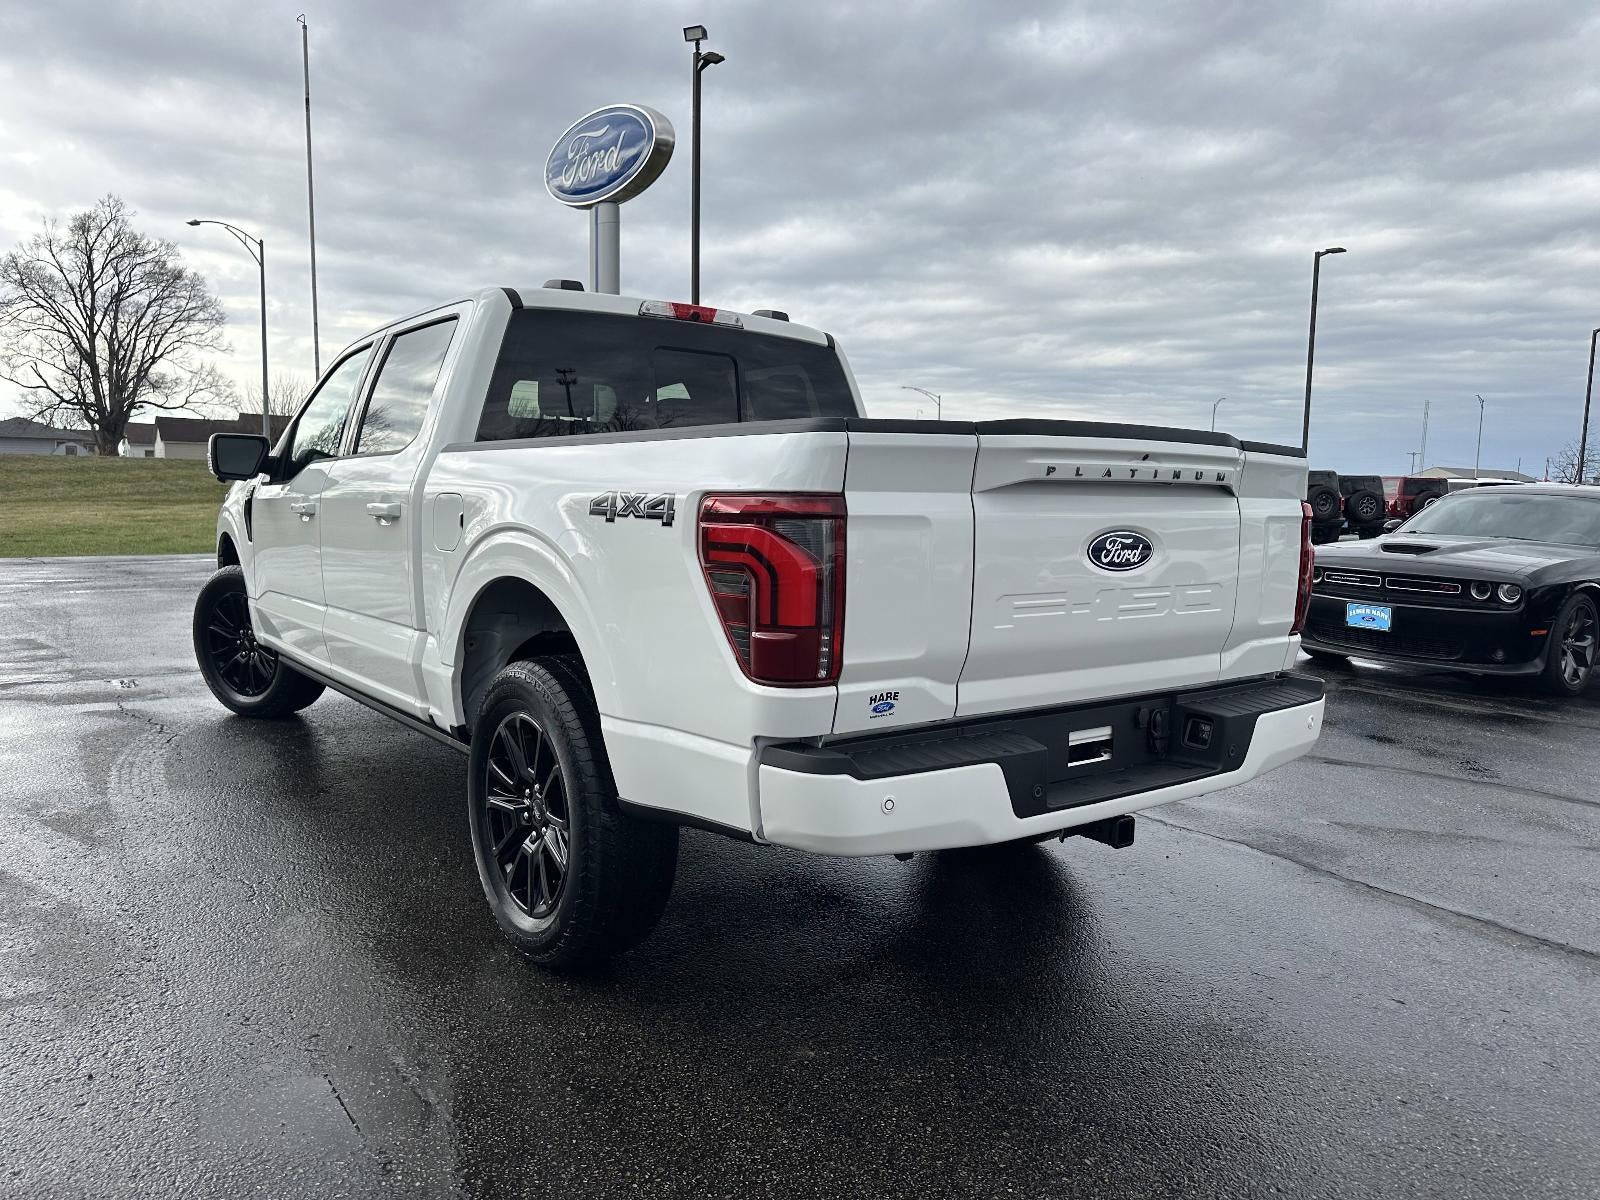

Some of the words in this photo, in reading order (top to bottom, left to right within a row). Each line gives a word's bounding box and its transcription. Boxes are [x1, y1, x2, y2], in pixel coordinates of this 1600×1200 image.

[562, 124, 626, 188] Ford
[1045, 465, 1226, 482] PLATINUM
[589, 490, 675, 527] 4X4
[1102, 537, 1143, 563] Ford
[869, 691, 900, 705] HARE
